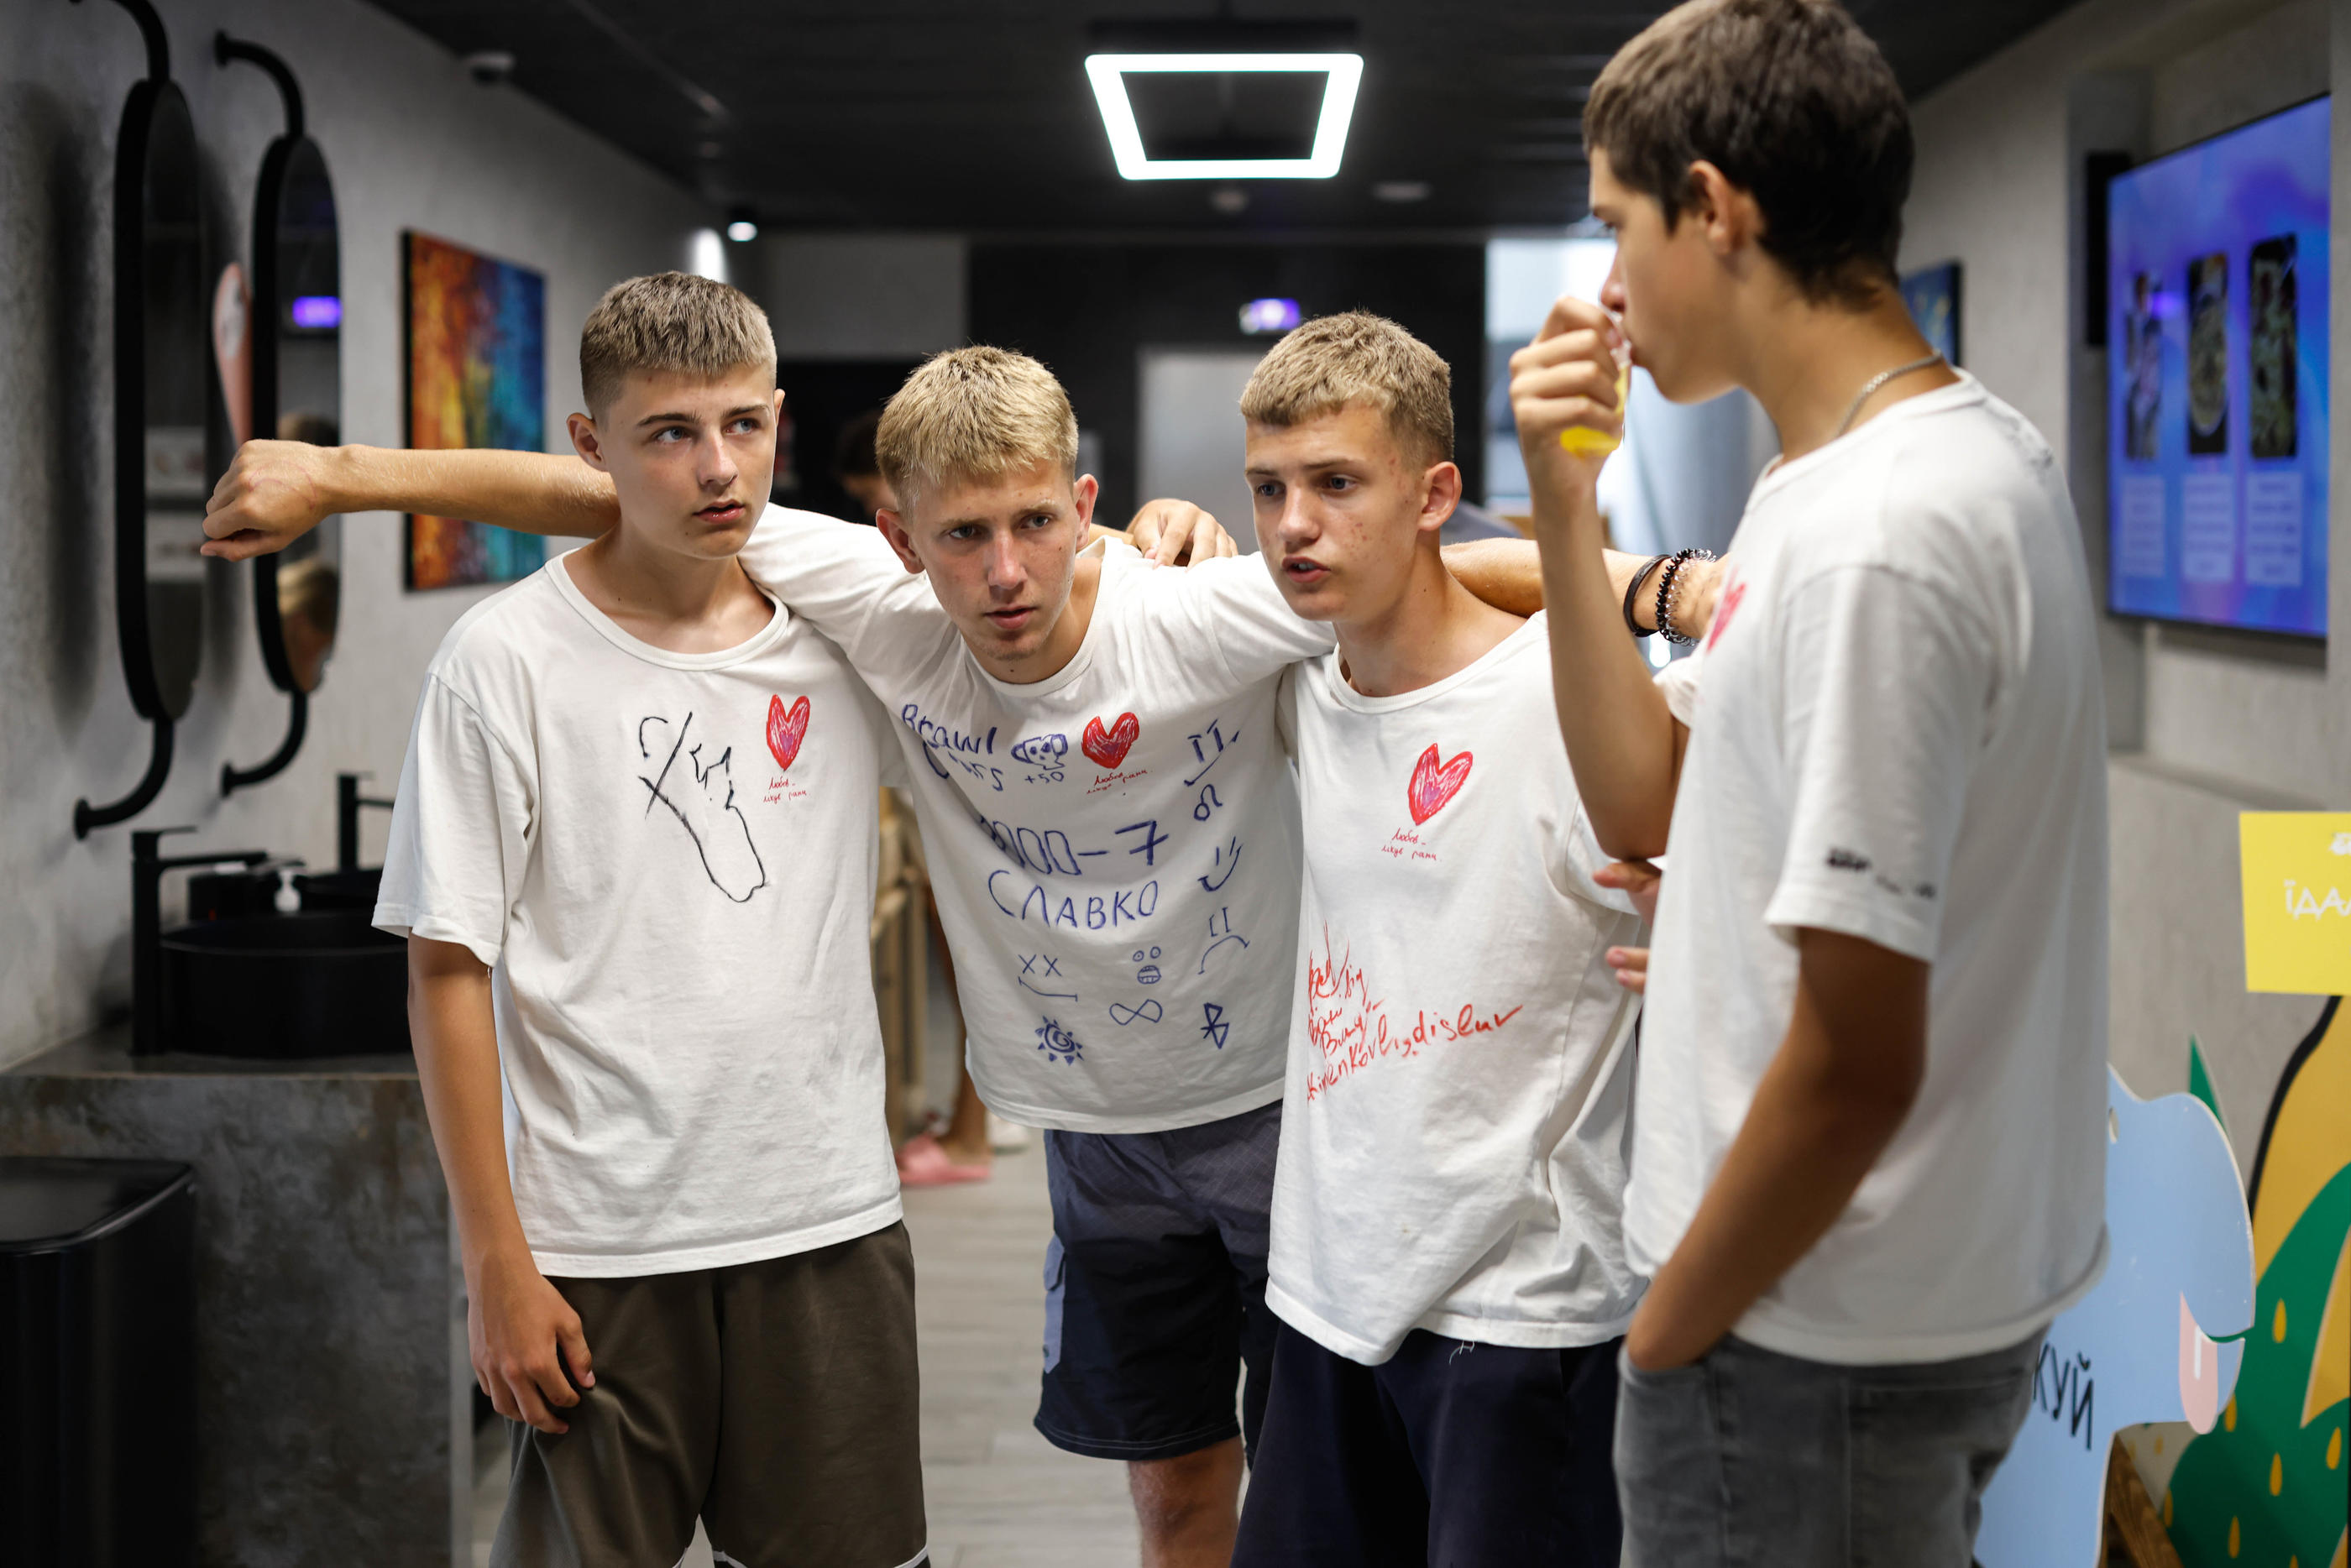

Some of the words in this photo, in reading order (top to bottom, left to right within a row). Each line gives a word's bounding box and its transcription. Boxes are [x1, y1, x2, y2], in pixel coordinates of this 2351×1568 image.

[902, 703, 997, 755] Brawl
[1024, 771, 1065, 784] +50
[987, 870, 1159, 930] СЛАВКО
